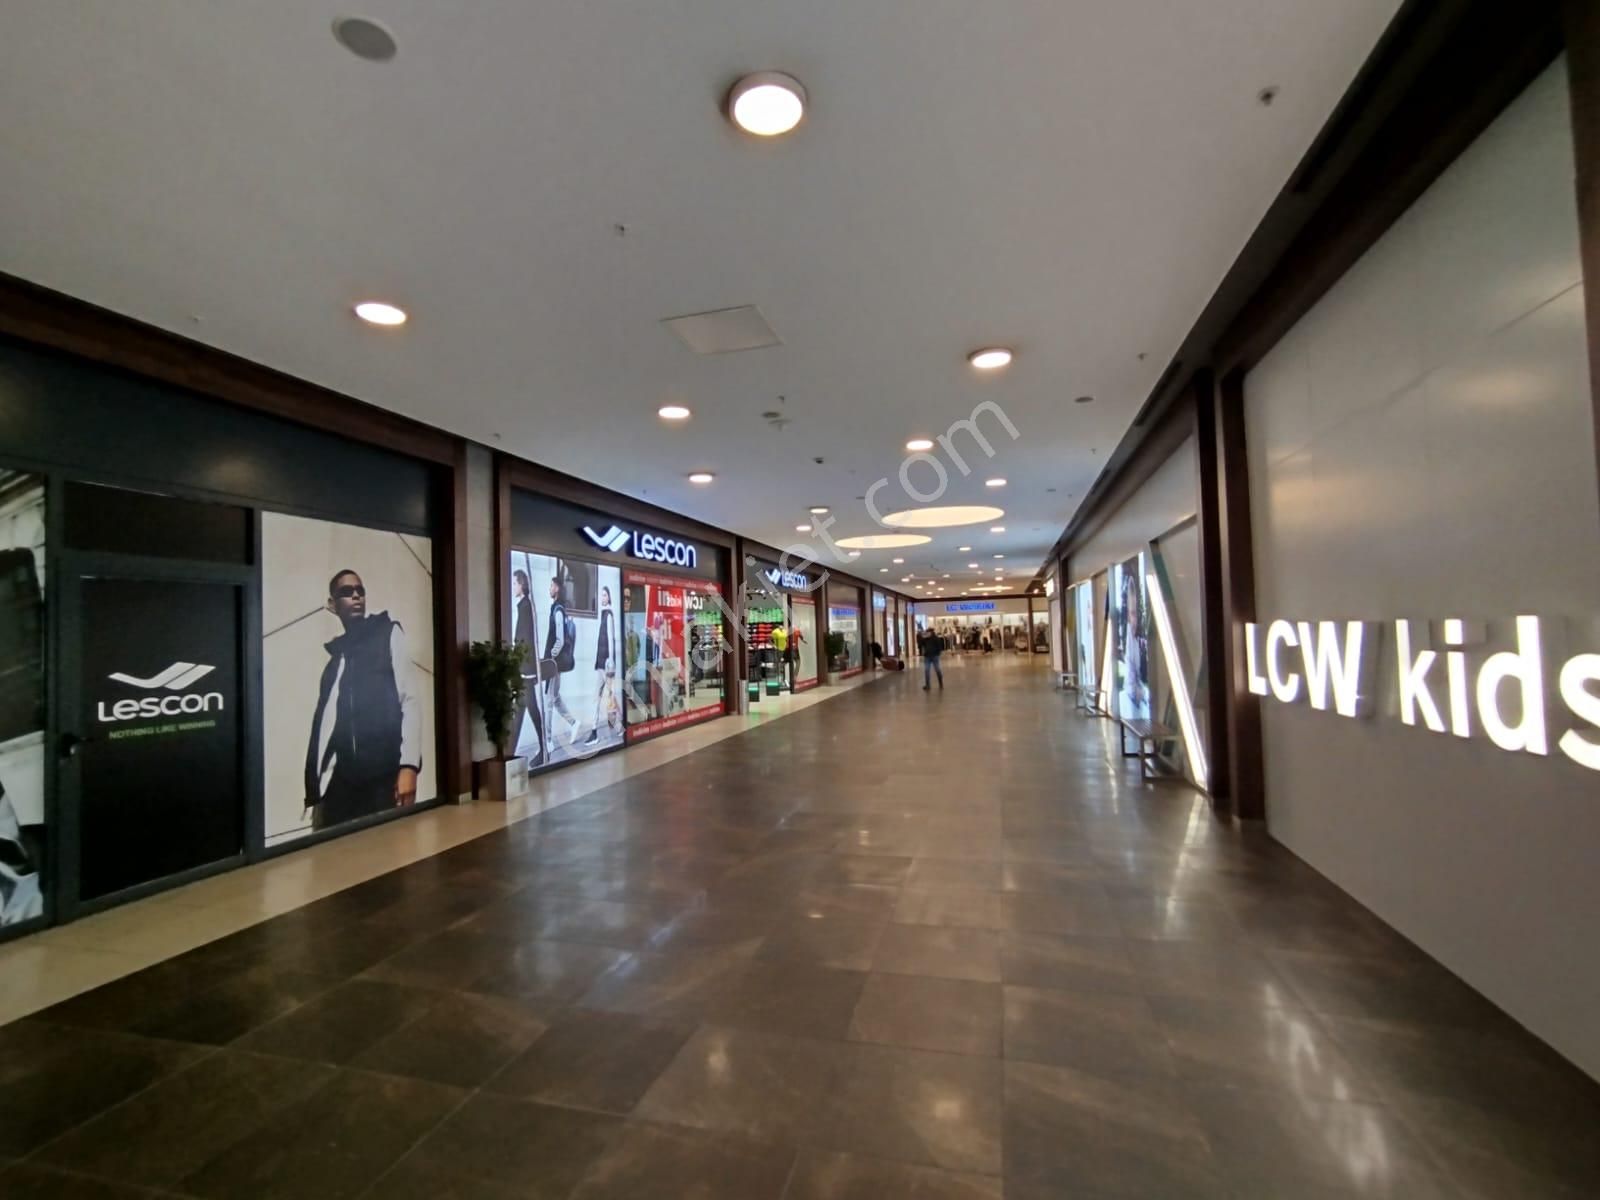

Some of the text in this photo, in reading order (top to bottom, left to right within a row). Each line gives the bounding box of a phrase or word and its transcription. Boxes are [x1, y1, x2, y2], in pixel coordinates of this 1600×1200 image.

[633, 530, 697, 568] Lescon
[97, 692, 224, 722] Lescon
[1244, 615, 1600, 771] LCW kids
[109, 727, 154, 740] NOTHING
